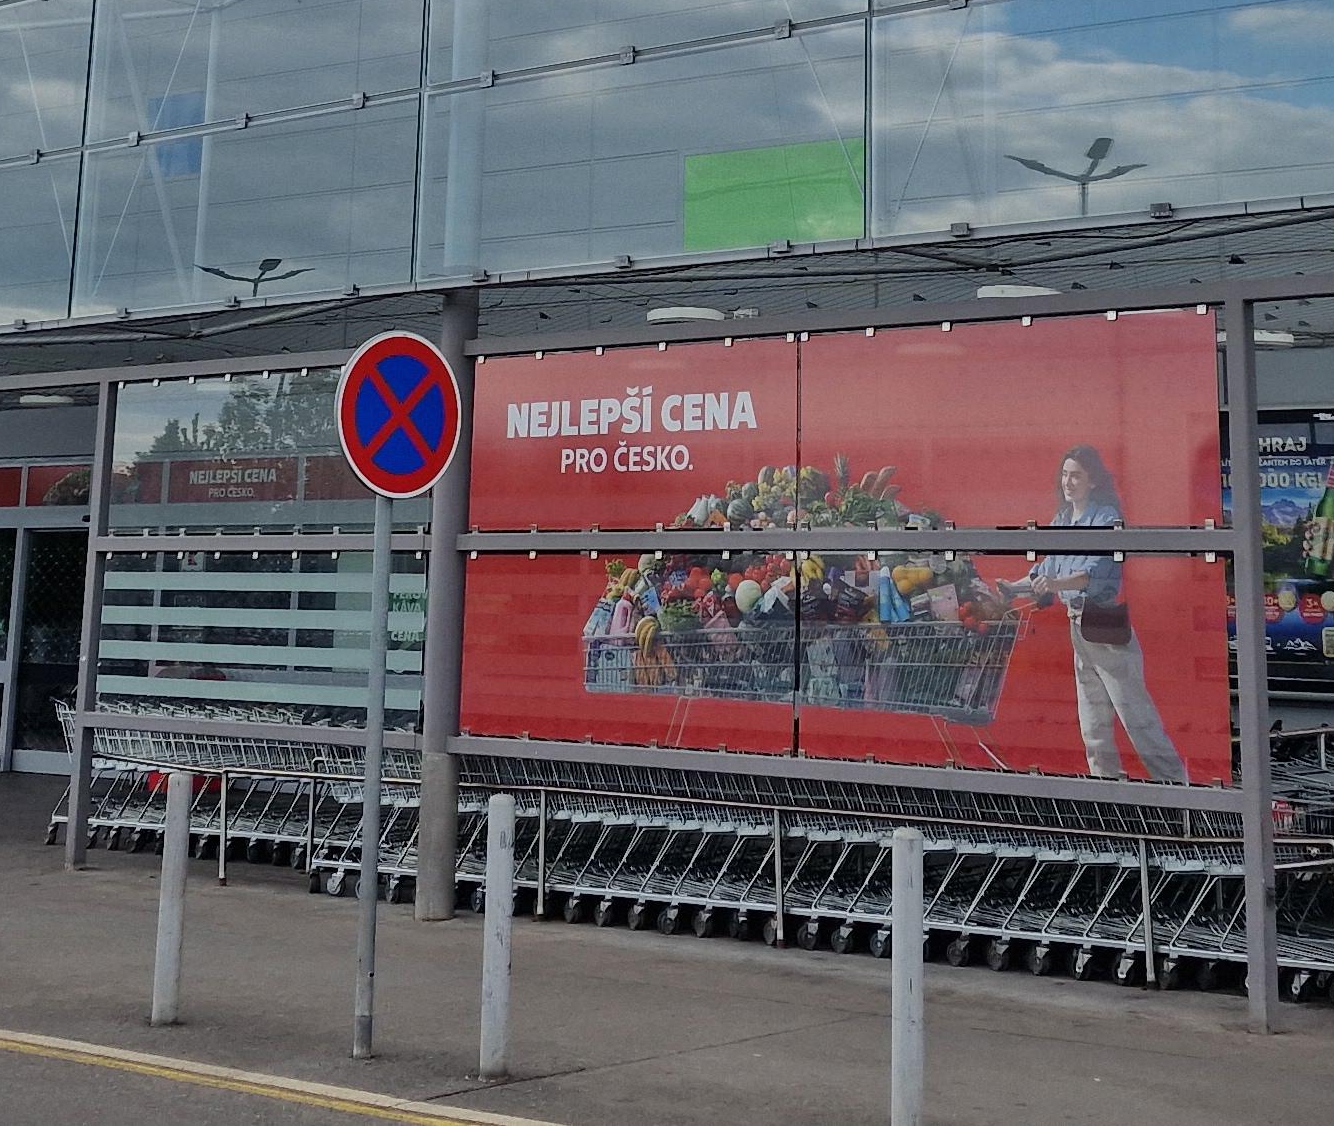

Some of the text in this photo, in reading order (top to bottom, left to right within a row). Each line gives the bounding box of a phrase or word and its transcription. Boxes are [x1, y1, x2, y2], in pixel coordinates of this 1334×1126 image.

[506, 385, 758, 439] NEJLEPŠÍ CENA
[560, 440, 694, 474] PRO ČESKO.
[244, 468, 277, 483] CENA
